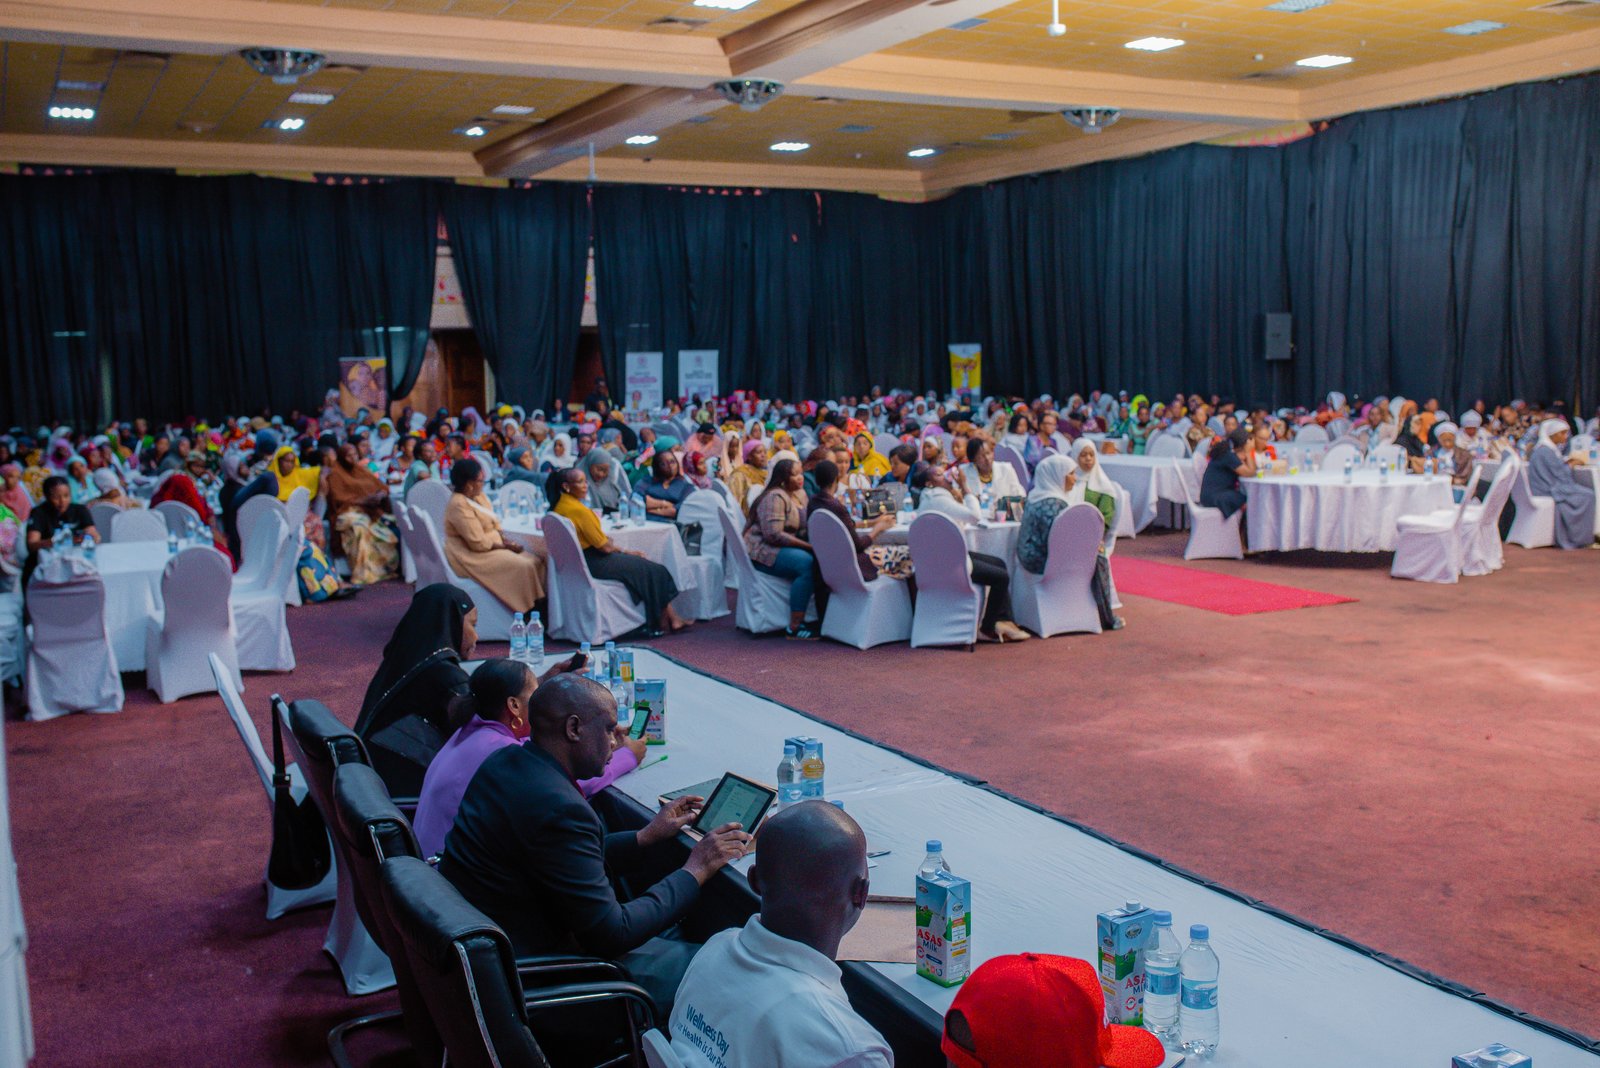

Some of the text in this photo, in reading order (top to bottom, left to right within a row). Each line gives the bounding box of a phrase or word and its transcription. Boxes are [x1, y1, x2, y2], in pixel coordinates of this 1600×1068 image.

[917, 928, 942, 947] ASAS
[682, 1025, 702, 1049] Health
[701, 1041, 708, 1053] is
[706, 1047, 716, 1063] Our
[686, 1003, 729, 1057] Wellness Day
